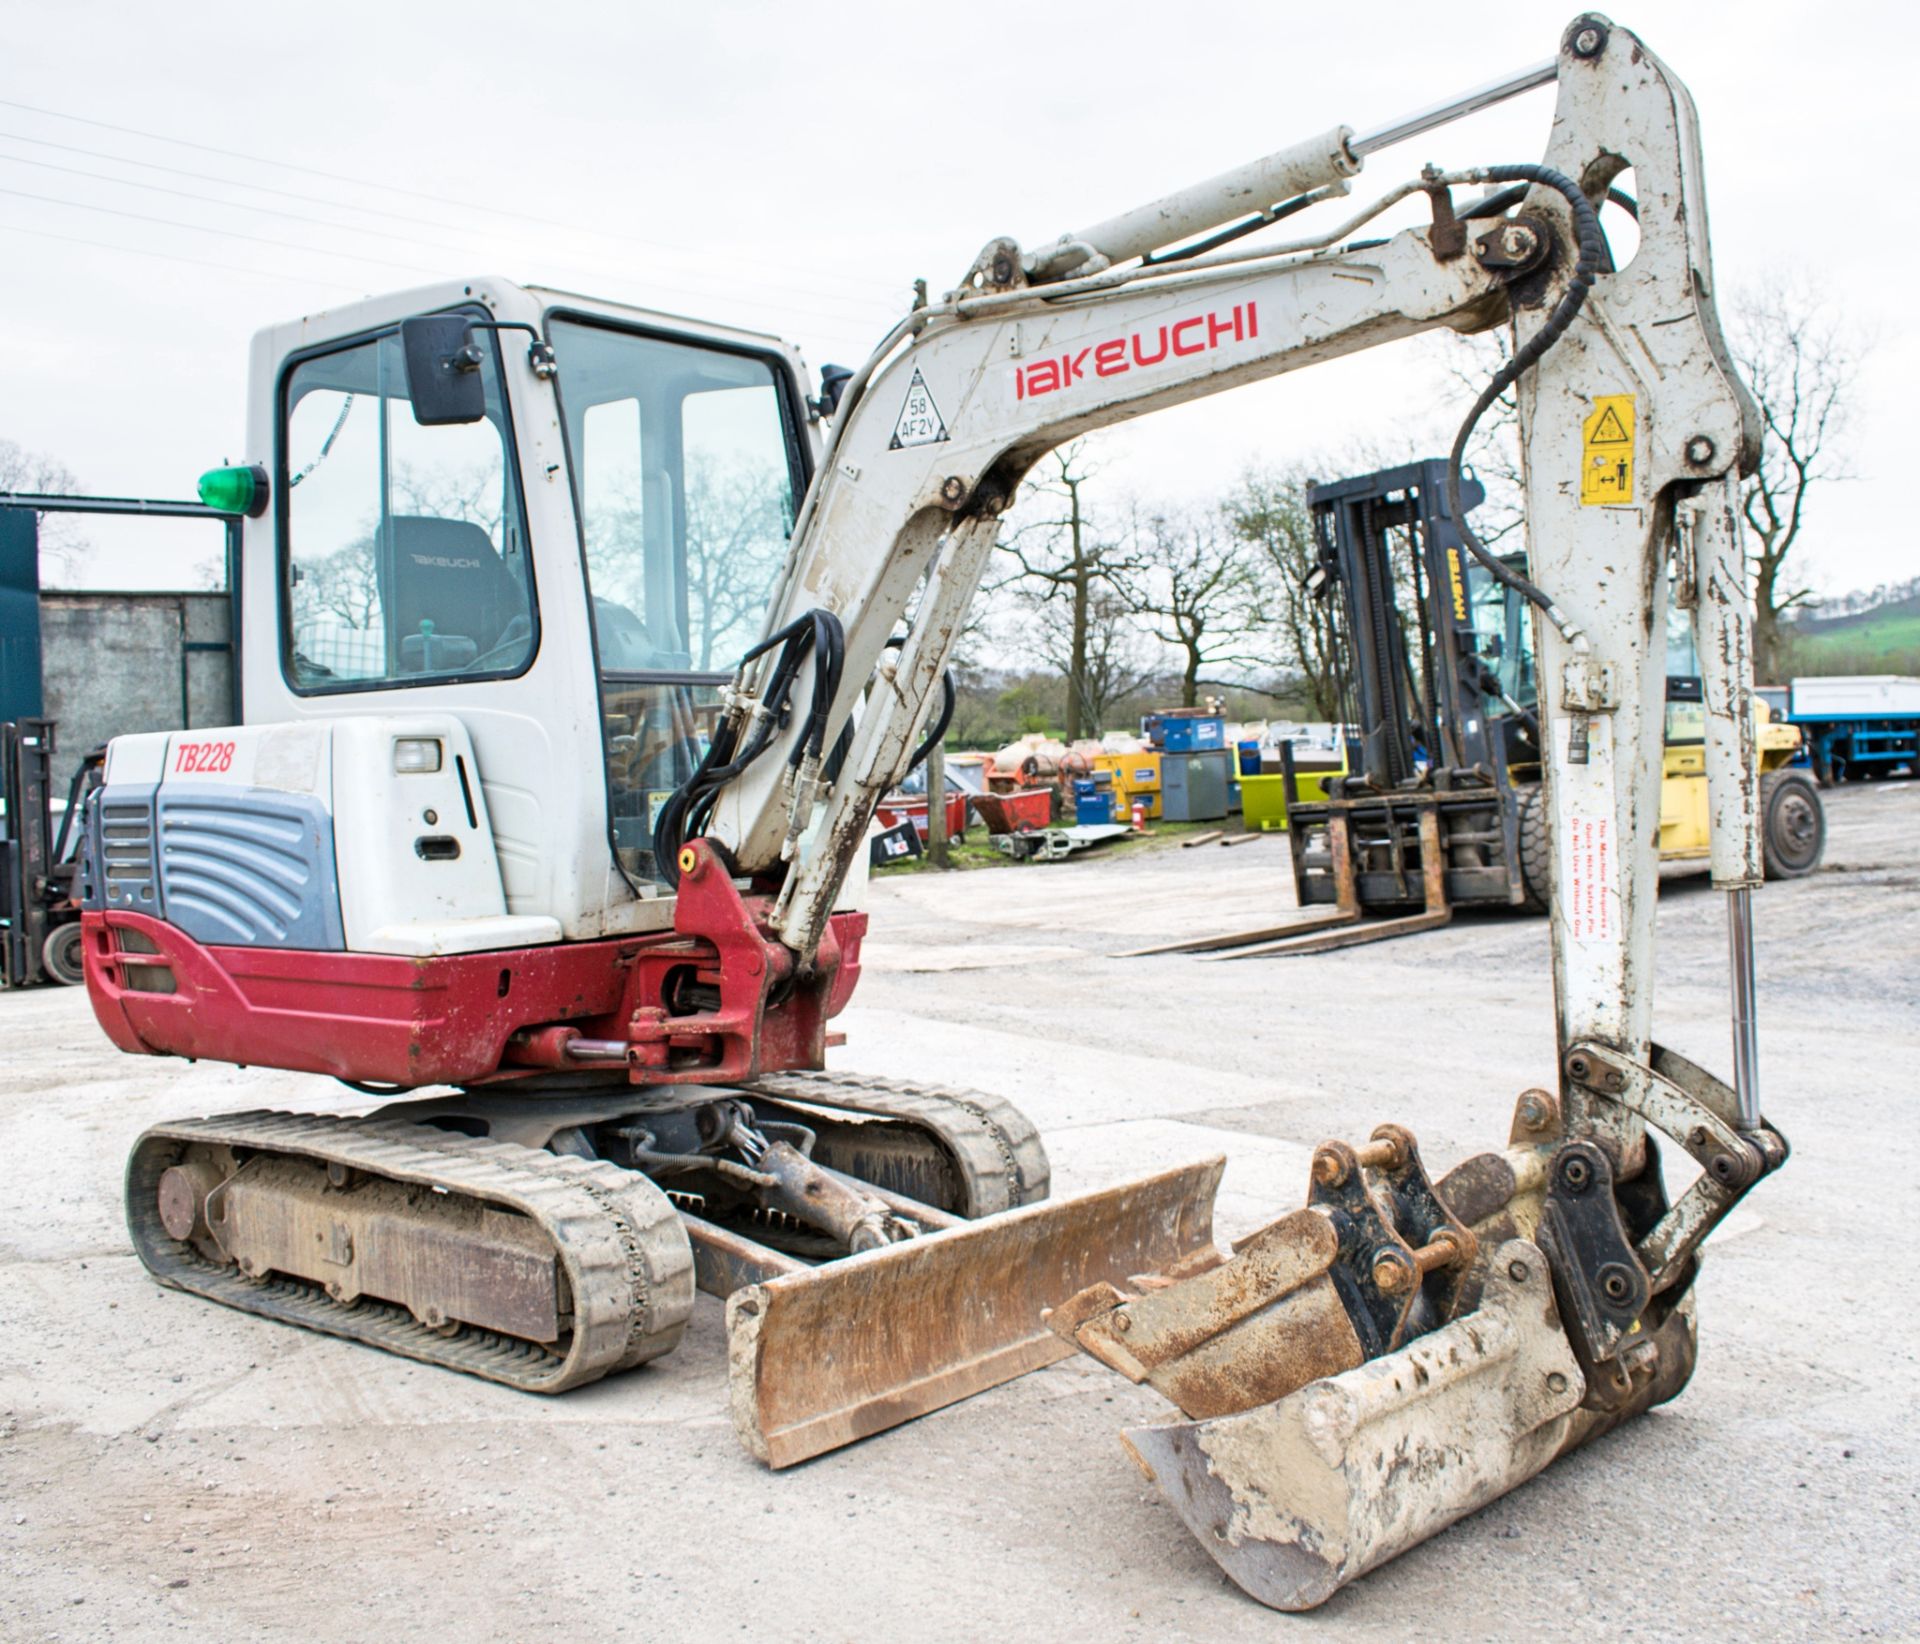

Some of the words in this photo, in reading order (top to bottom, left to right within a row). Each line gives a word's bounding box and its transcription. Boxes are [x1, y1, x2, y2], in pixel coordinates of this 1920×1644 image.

[910, 397, 927, 416] 58
[902, 417, 935, 438] AF2Y
[410, 553, 481, 569] TAKEUCHI
[1446, 547, 1467, 620] HYSTER
[175, 742, 236, 773] TB228
[1572, 818, 1579, 831] Do
[1585, 823, 1593, 849] Quick
[1586, 884, 1594, 914] Safety
